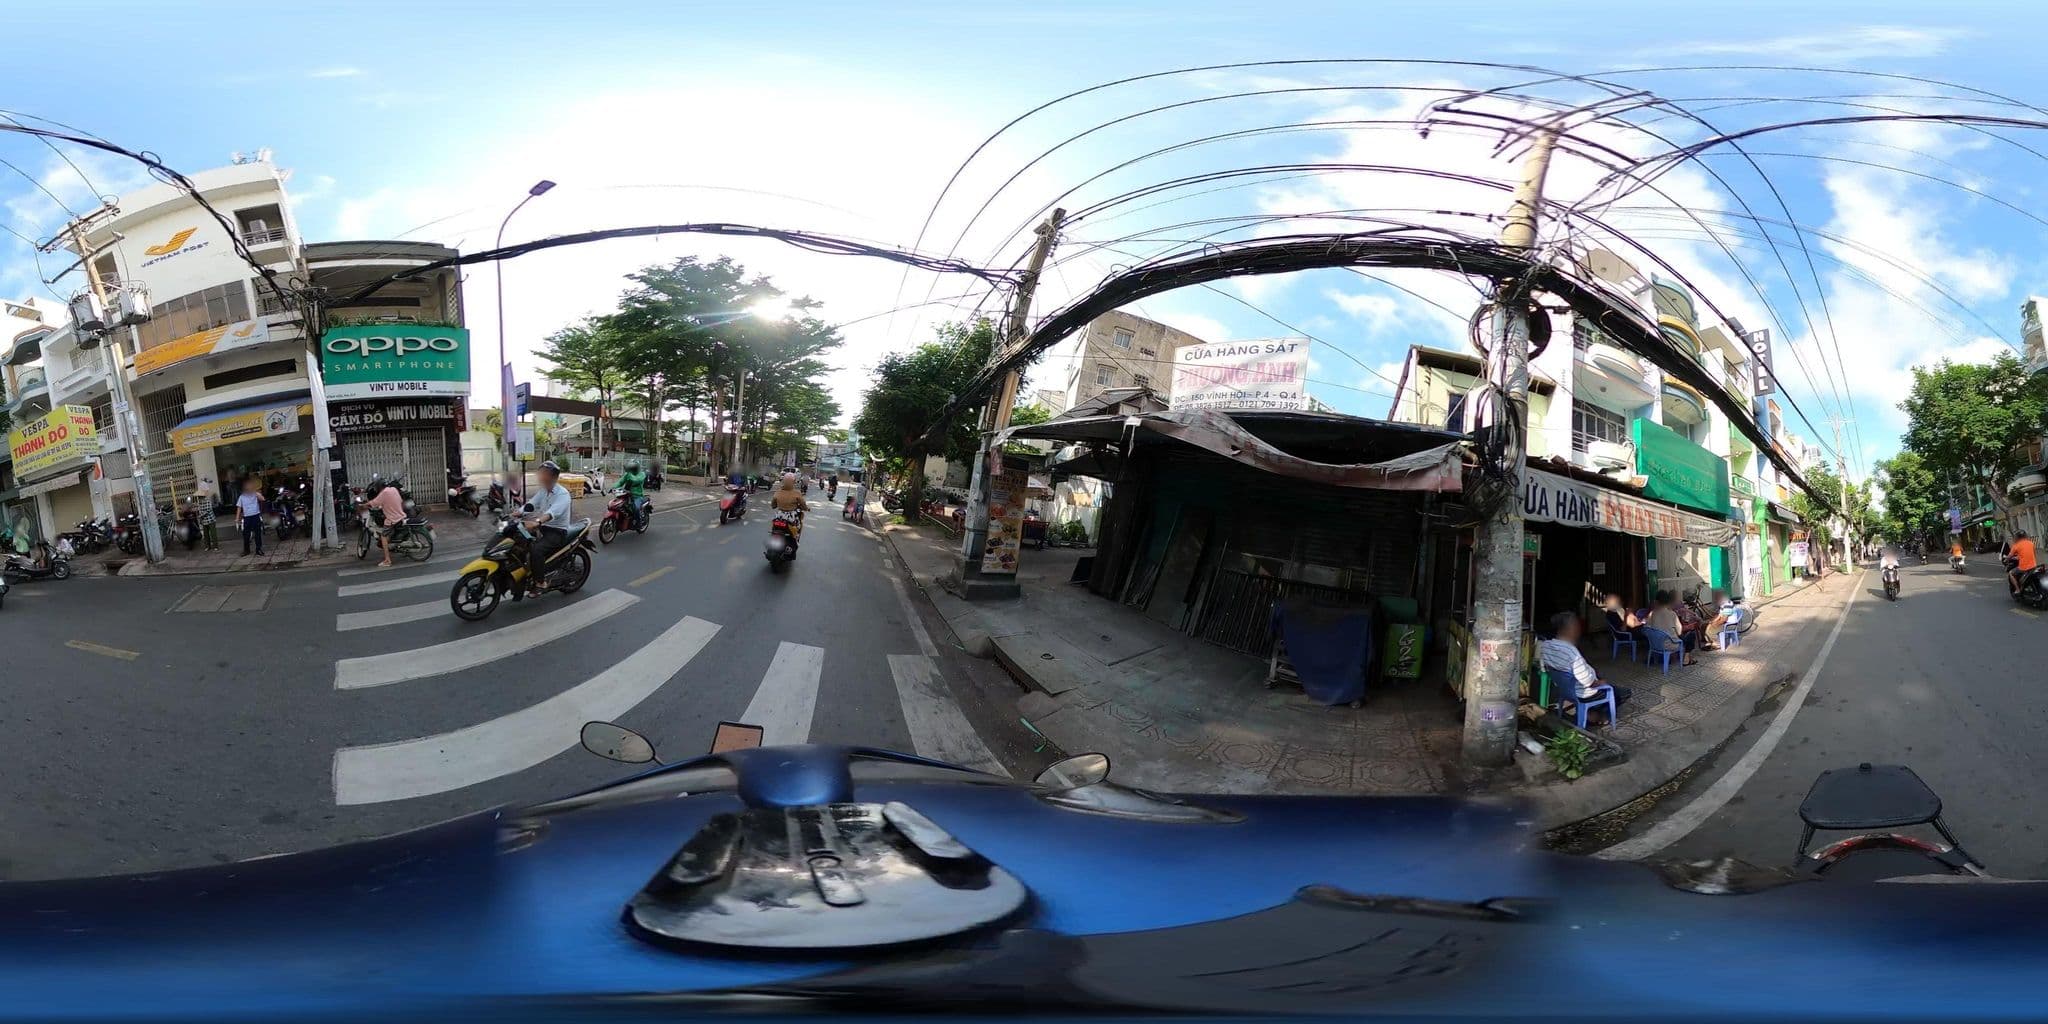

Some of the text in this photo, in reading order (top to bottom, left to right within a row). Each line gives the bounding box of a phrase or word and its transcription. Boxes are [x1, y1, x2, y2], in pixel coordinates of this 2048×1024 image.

[183, 241, 209, 253] POST
[335, 361, 455, 371] SMARTPHONE
[369, 382, 427, 391] VINTU MOBILE
[69, 406, 90, 414] VESPA
[386, 405, 417, 420] VINTU
[419, 404, 454, 419] MOBILE
[22, 419, 49, 438] VESPA
[1524, 477, 1549, 517] ỬA
[1556, 488, 1600, 524] HÀNG
